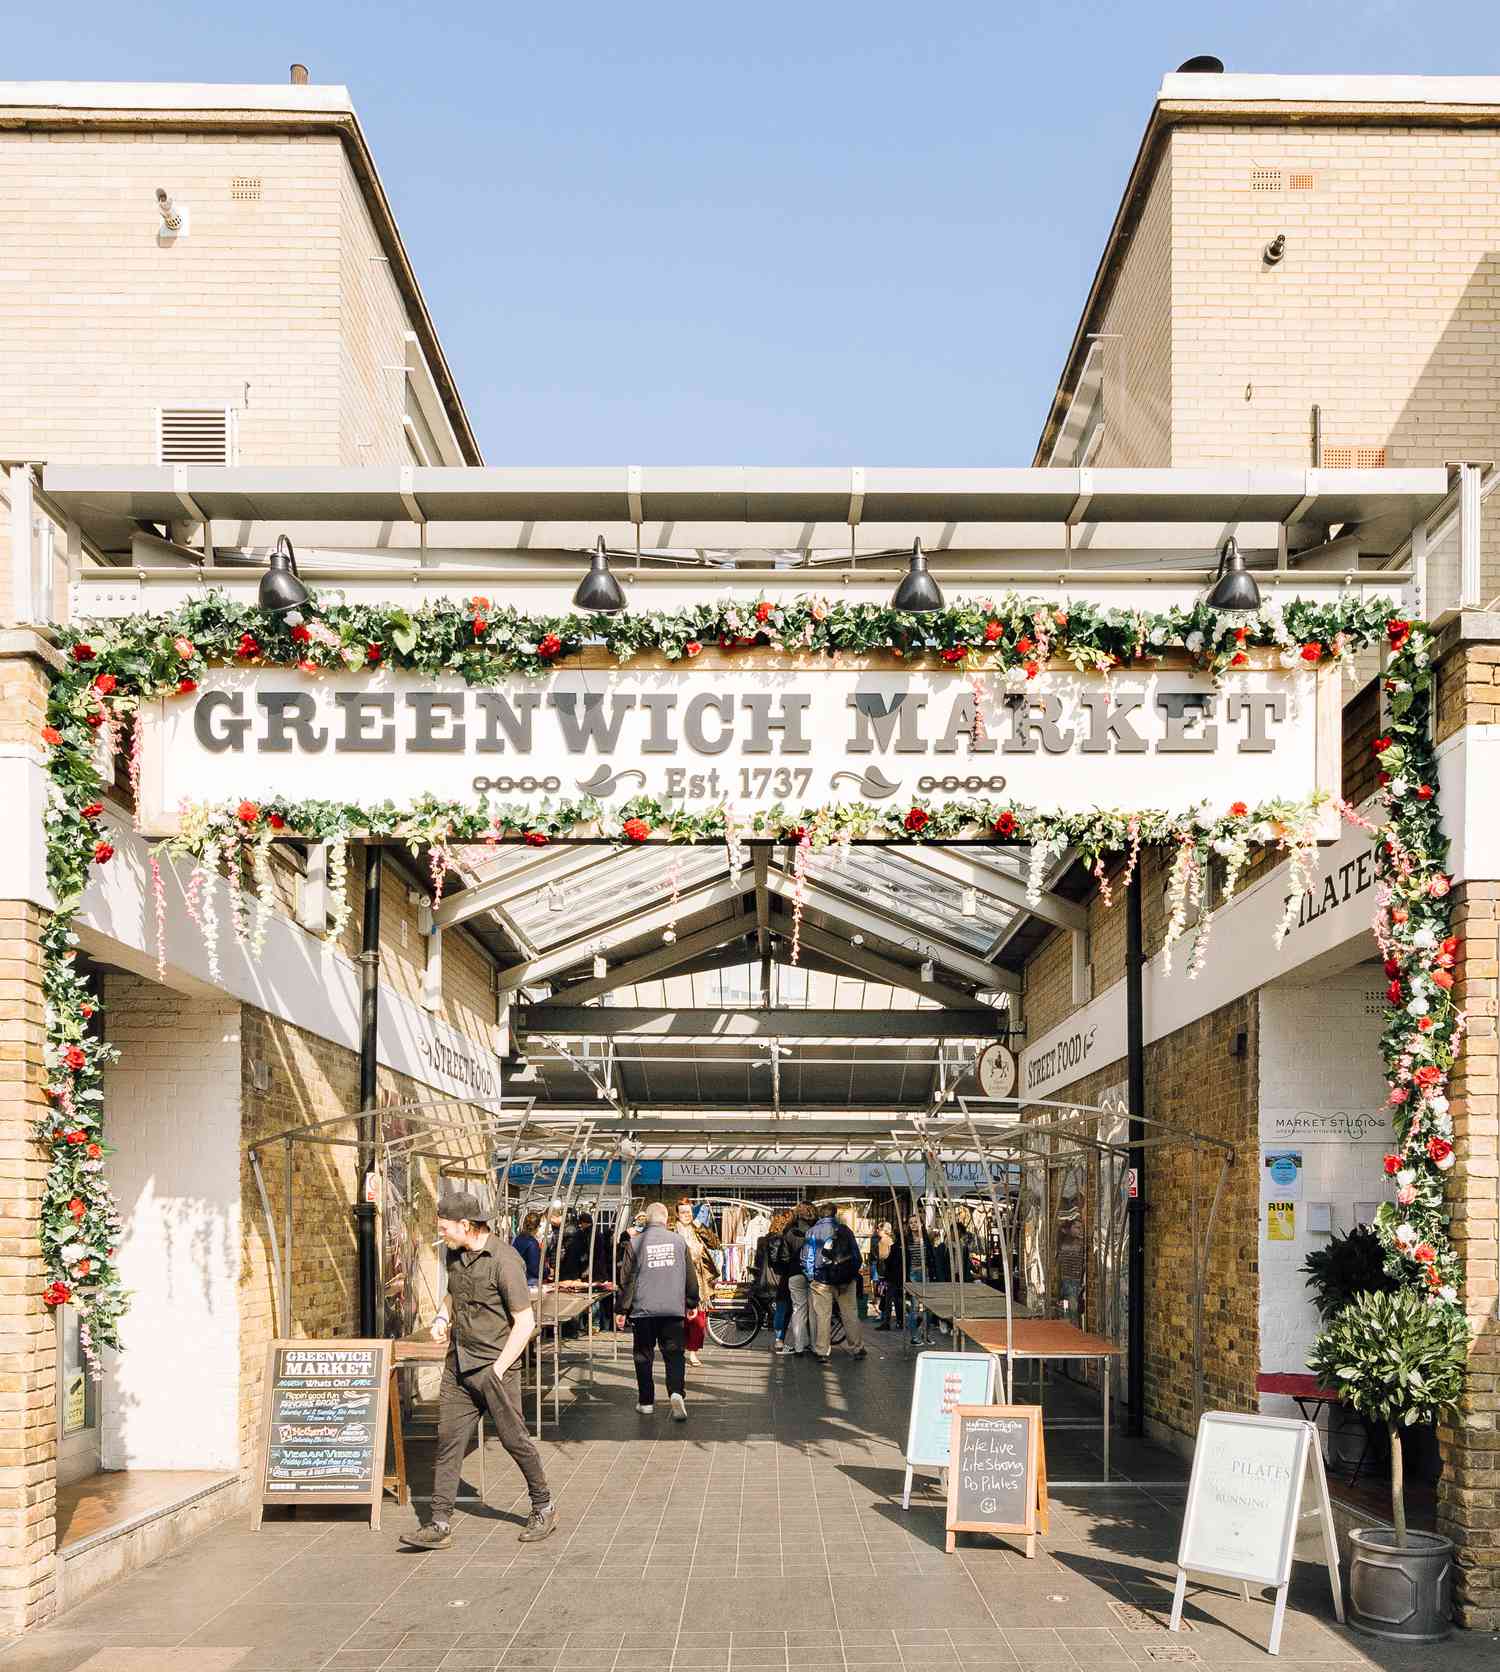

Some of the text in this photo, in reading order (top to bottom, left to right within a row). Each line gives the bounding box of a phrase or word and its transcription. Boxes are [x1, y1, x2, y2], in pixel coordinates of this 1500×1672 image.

[193, 690, 1287, 756] GREENWICH MARKET
[738, 767, 813, 799] 1737
[434, 1037, 469, 1084] STREET
[1028, 1033, 1082, 1089] STREET FOOD
[1276, 1119, 1386, 1128] MARKET STUDIOS
[680, 1164, 726, 1176] WEARS
[730, 1164, 787, 1176] LONDON
[1268, 1203, 1294, 1211] RUN
[286, 1351, 372, 1361] GREENWICH
[285, 1362, 372, 1376] MARKET
[305, 1379, 331, 1388] Whats
[333, 1379, 351, 1388] On?
[308, 1392, 325, 1400] good
[326, 1391, 339, 1399] fun
[990, 1437, 1016, 1456] Live
[1231, 1459, 1291, 1480] PILATES
[965, 1475, 978, 1490] Do
